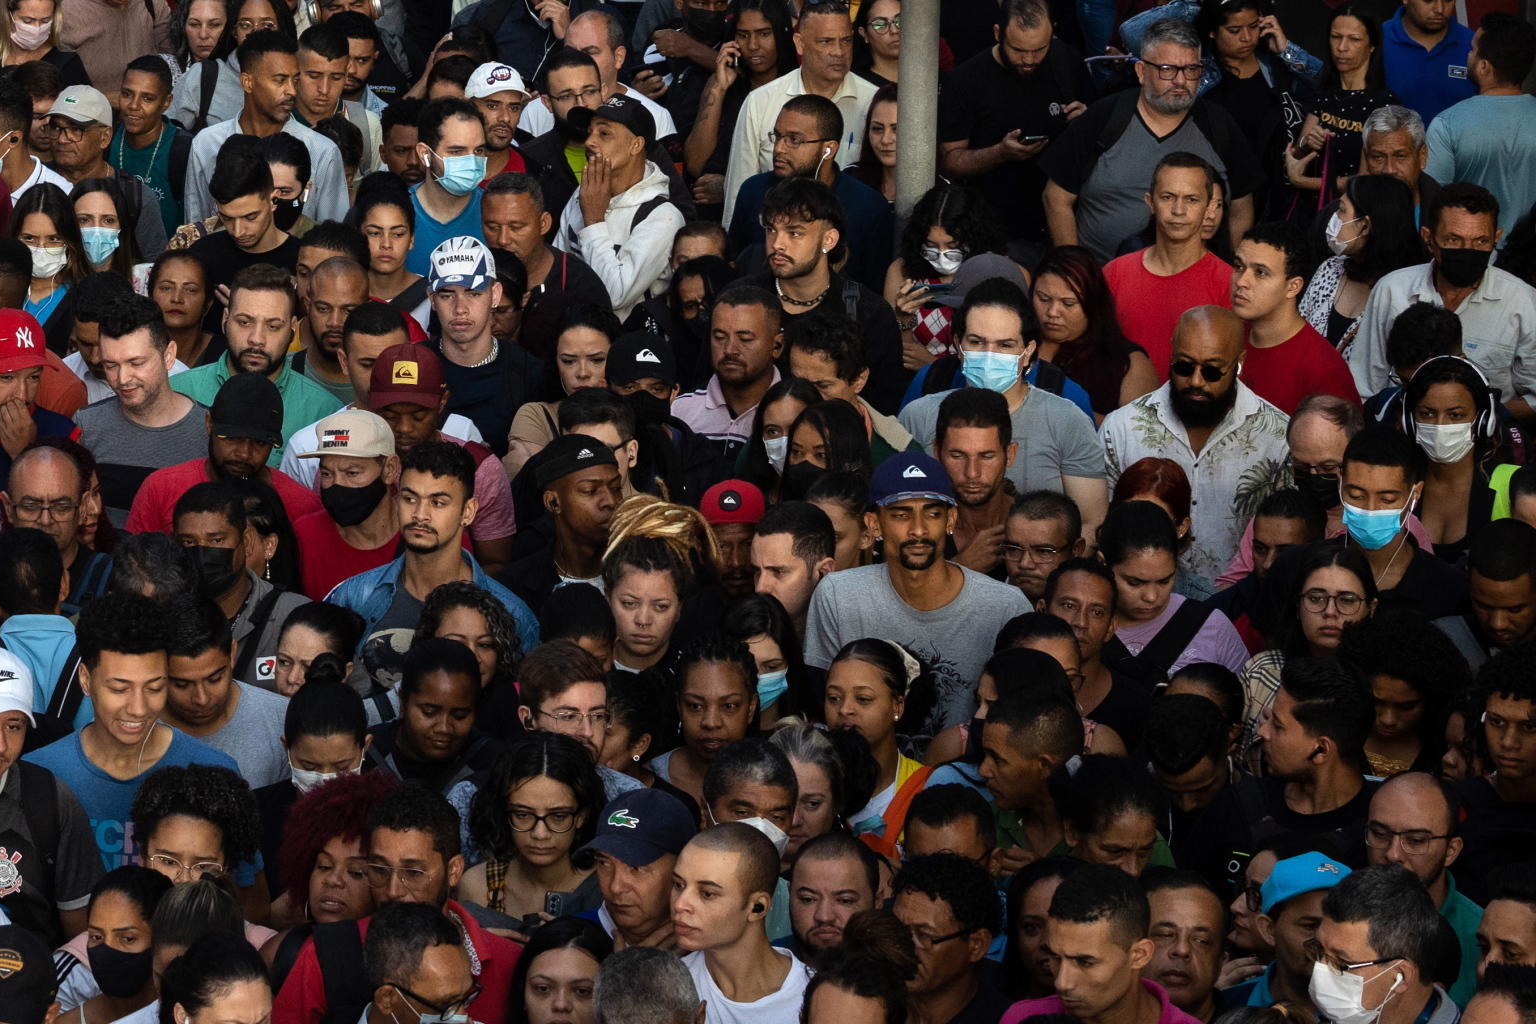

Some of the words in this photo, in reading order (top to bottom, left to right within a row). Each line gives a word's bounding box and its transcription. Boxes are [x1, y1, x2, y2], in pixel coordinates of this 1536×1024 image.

[446, 254, 475, 264] YAMAHA
[15, 325, 35, 349] NY
[323, 429, 350, 437] TOMMY
[1509, 426, 1524, 445] USP
[322, 441, 349, 449] DENIM
